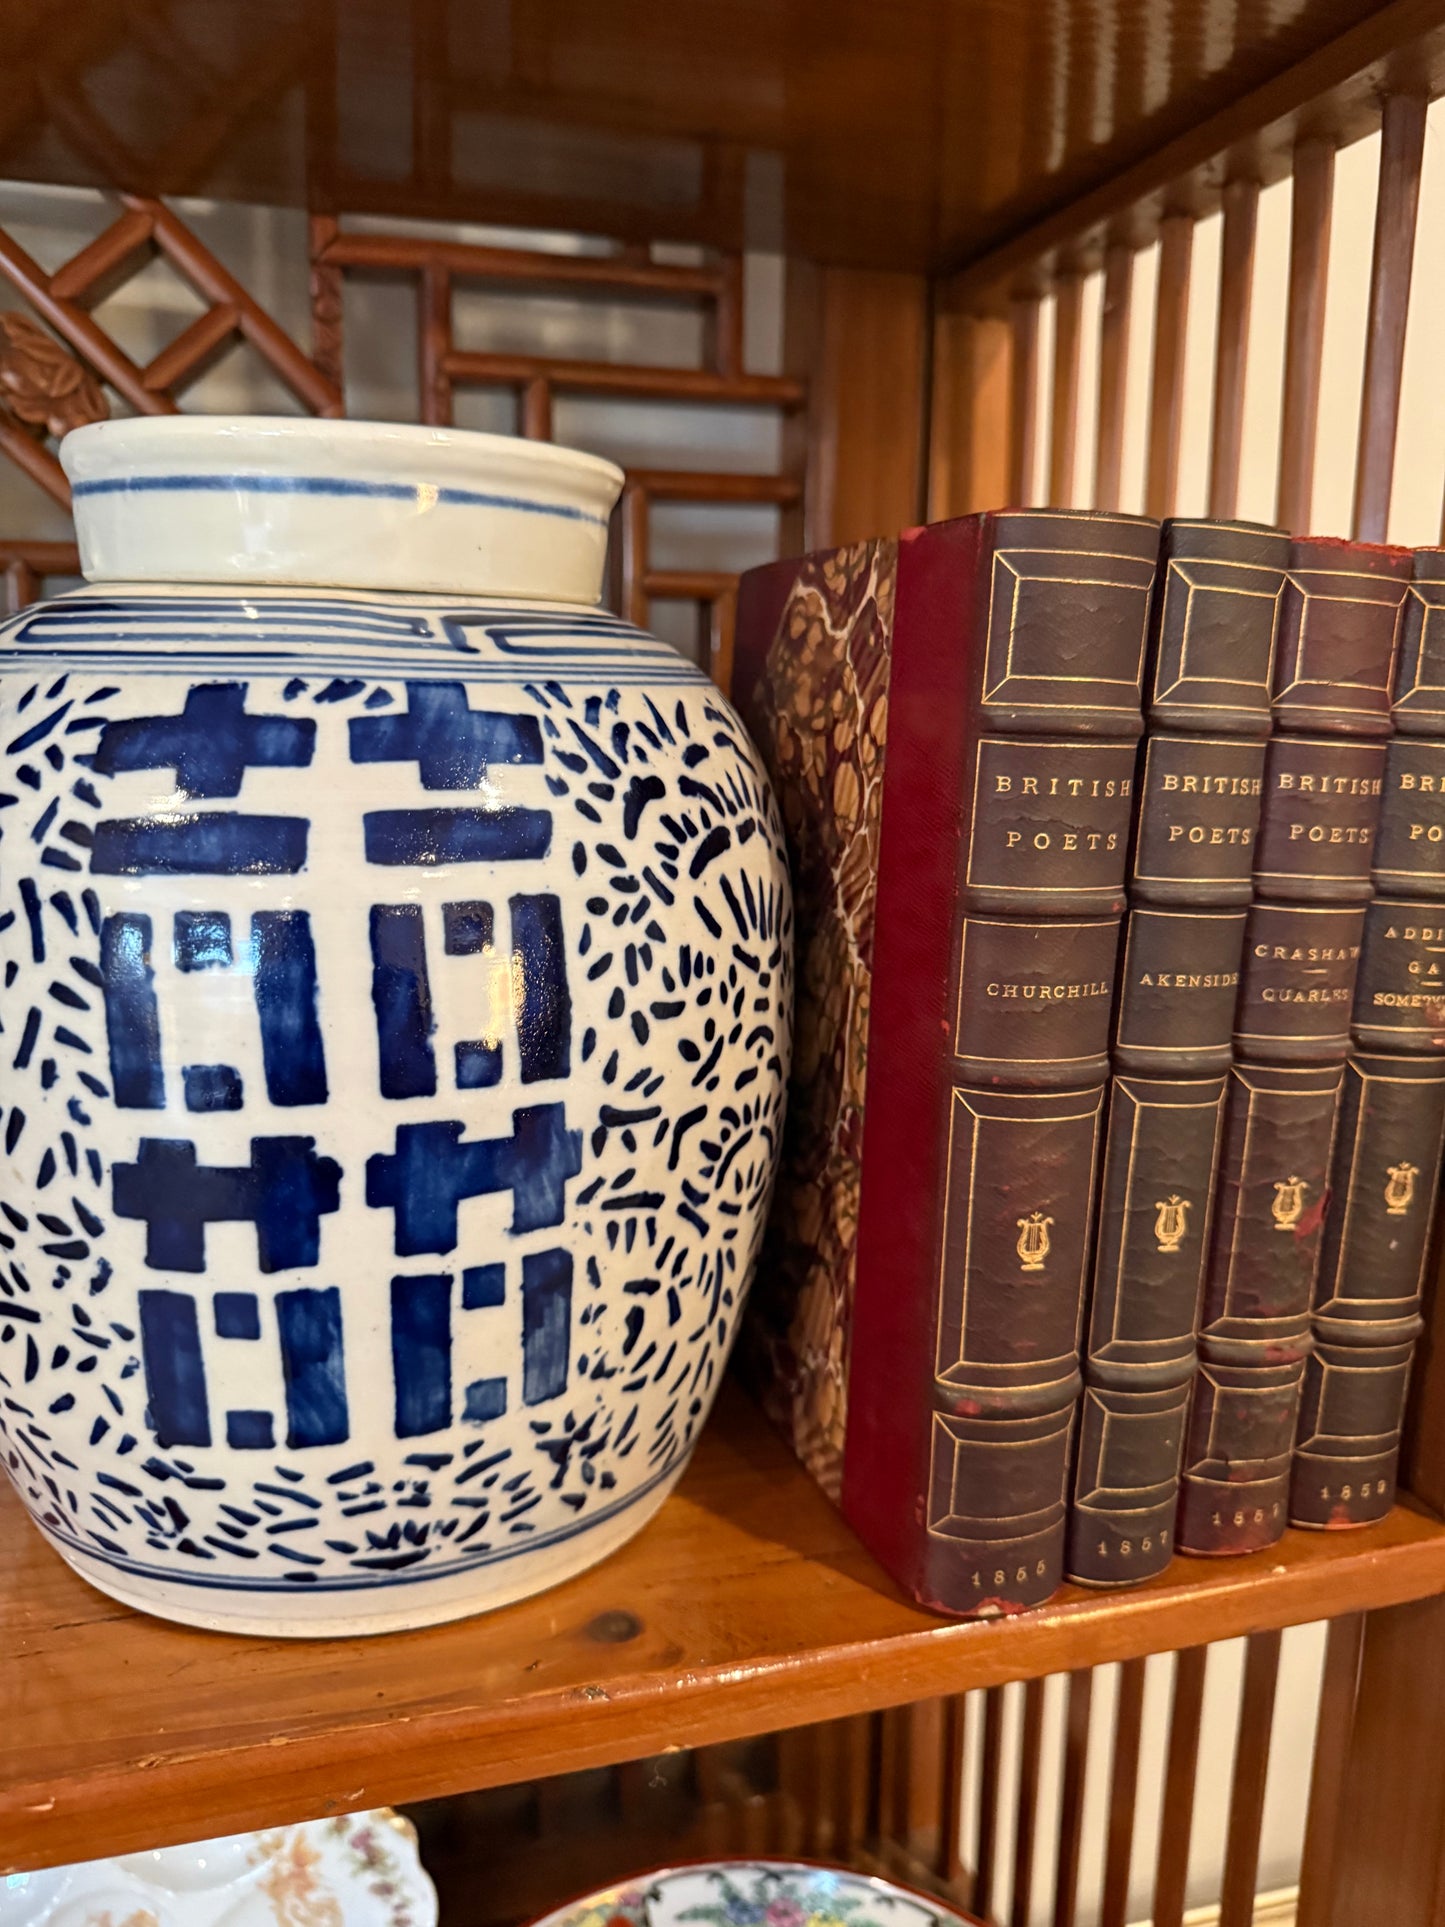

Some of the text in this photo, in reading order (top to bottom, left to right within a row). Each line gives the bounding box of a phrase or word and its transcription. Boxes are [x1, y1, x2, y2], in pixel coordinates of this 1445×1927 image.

[995, 776, 1131, 797] BRITISH
[1161, 775, 1261, 796] BRITISH
[1277, 774, 1382, 795] BRITISH
[1006, 831, 1117, 850] POETS
[1168, 825, 1251, 845] POETS
[1288, 824, 1370, 844] POETS
[986, 981, 1109, 999] CHURCHILL
[1139, 972, 1239, 988] AKENSIDE
[1262, 988, 1348, 1003] QUARLES
